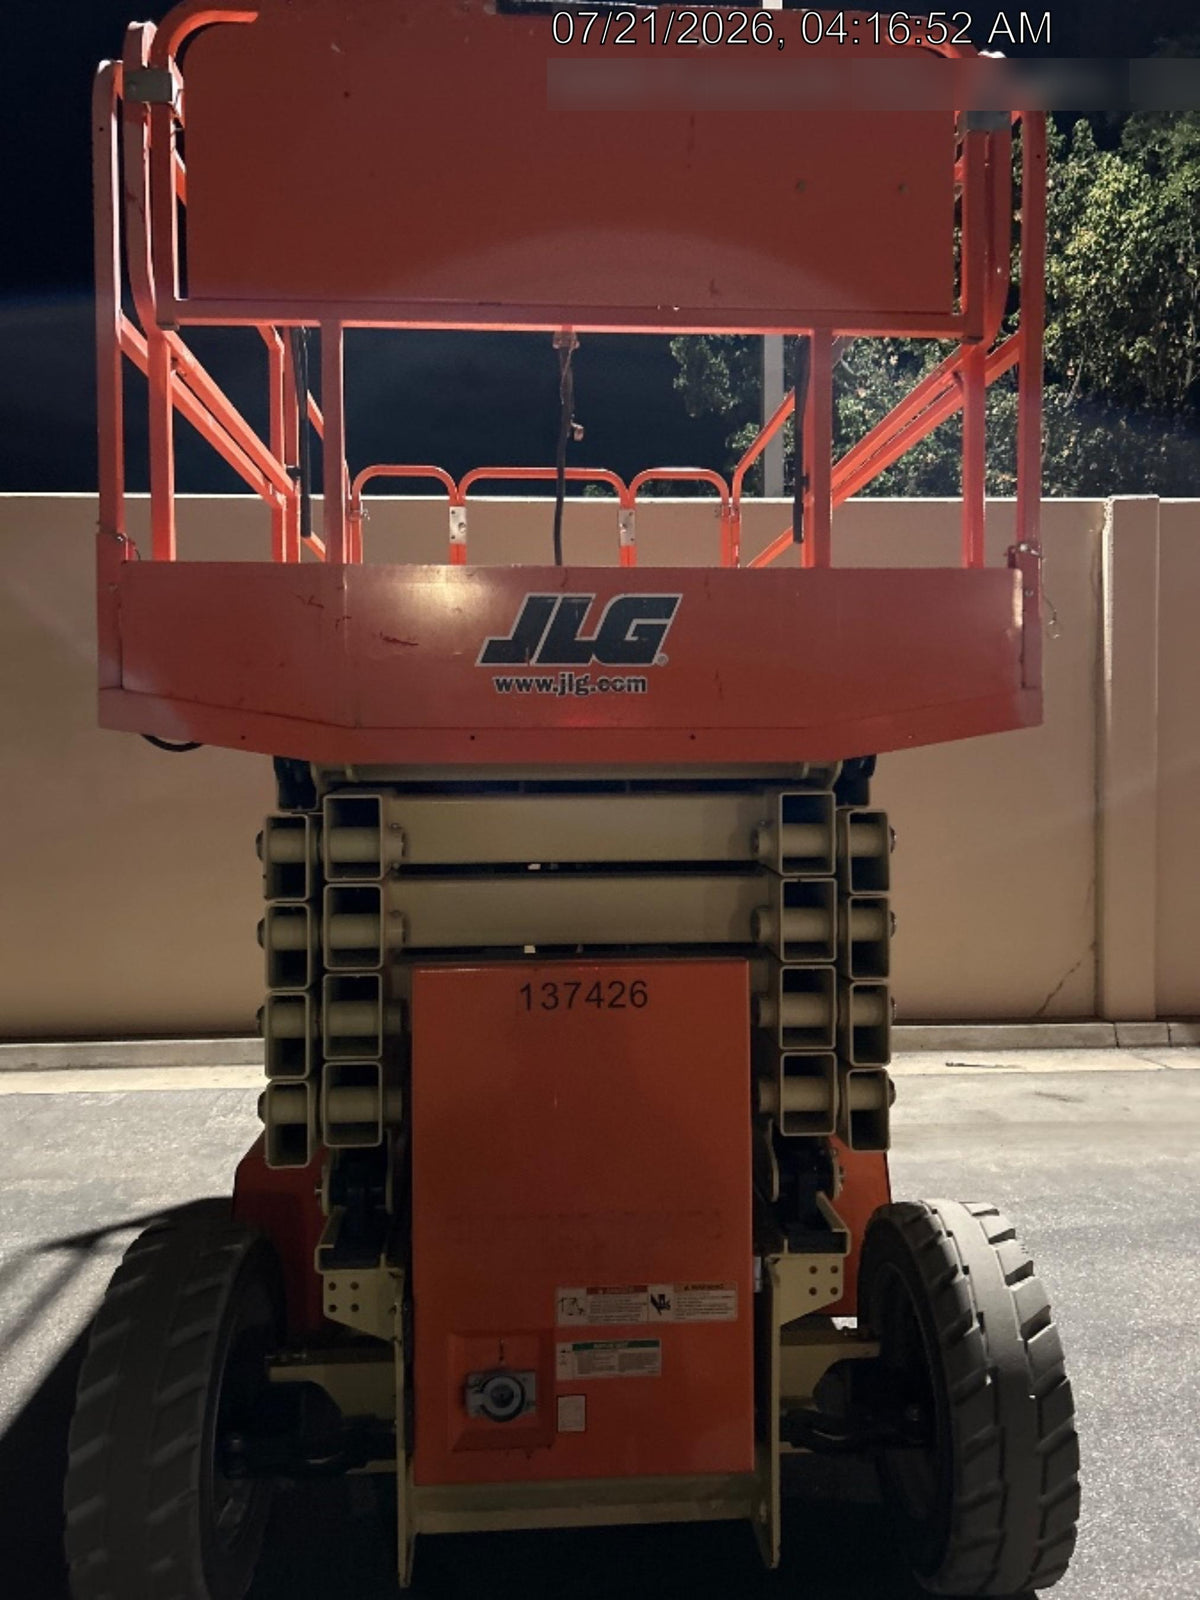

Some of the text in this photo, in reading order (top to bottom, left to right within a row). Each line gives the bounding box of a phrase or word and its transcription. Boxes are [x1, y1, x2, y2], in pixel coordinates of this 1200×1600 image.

[475, 593, 683, 667] JLG
[493, 672, 647, 696] www.jlg.com
[519, 980, 649, 1011] 137426
